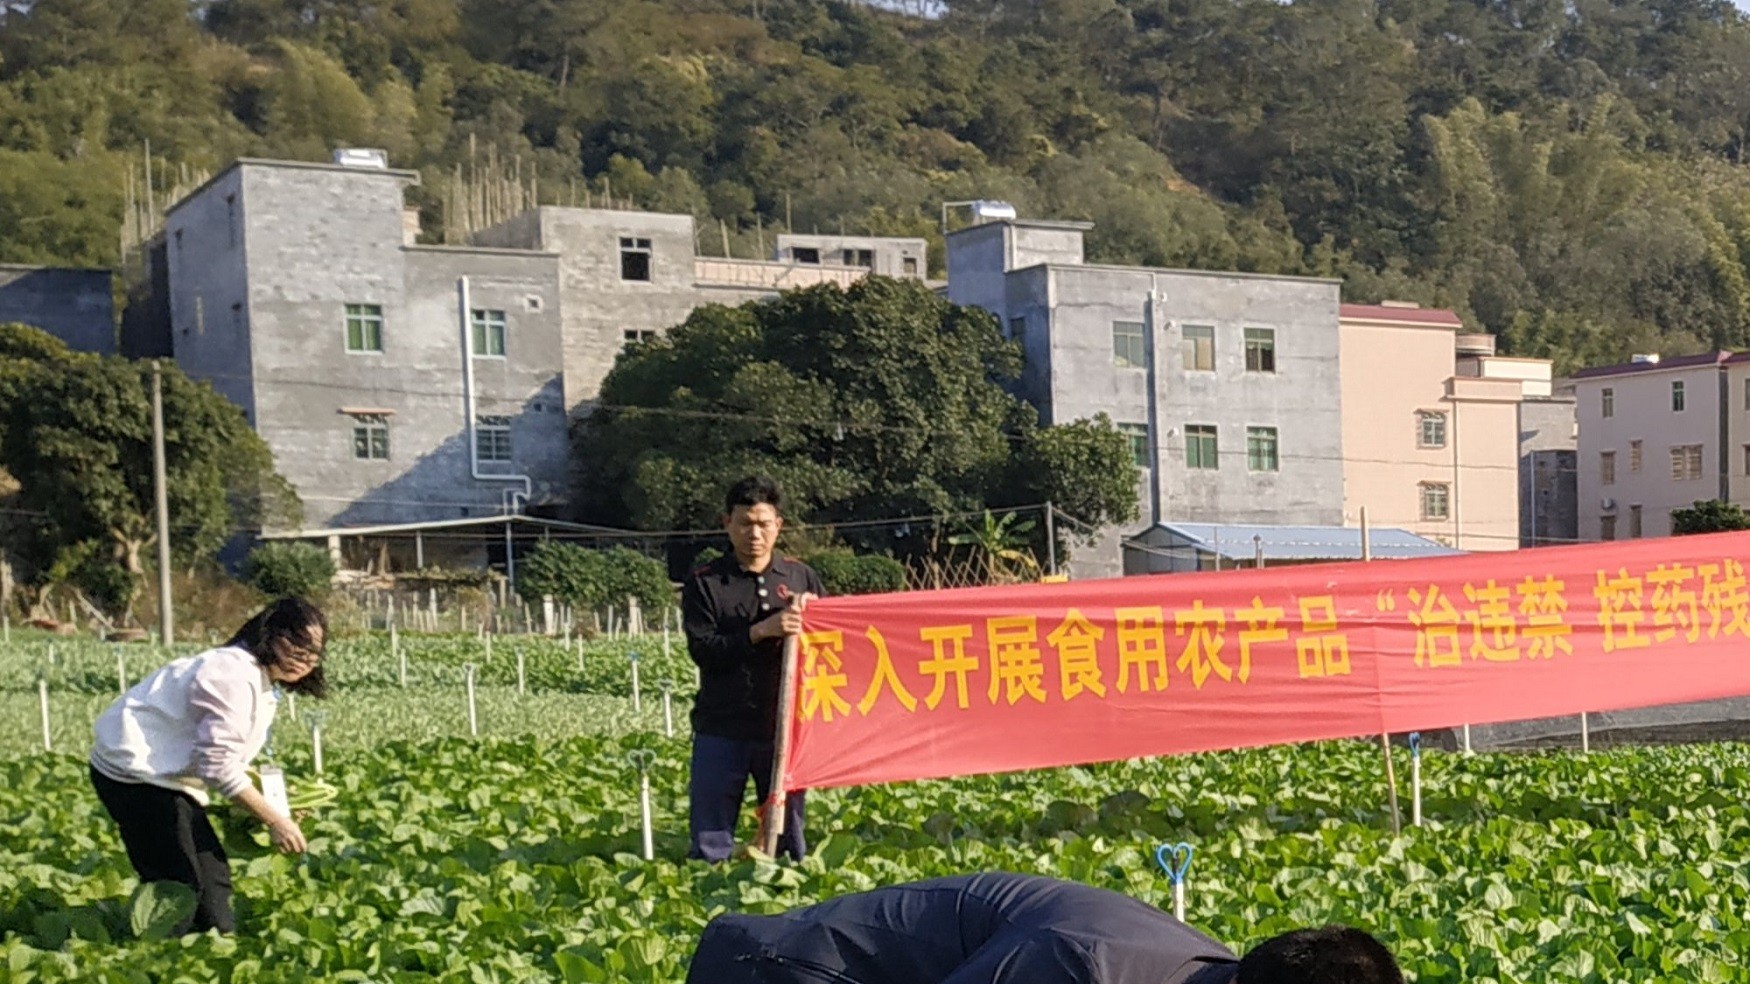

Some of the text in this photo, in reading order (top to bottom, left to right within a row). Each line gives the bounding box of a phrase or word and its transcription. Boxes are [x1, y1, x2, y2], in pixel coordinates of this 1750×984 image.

[799, 594, 1352, 723] 深入开展食用农产品
